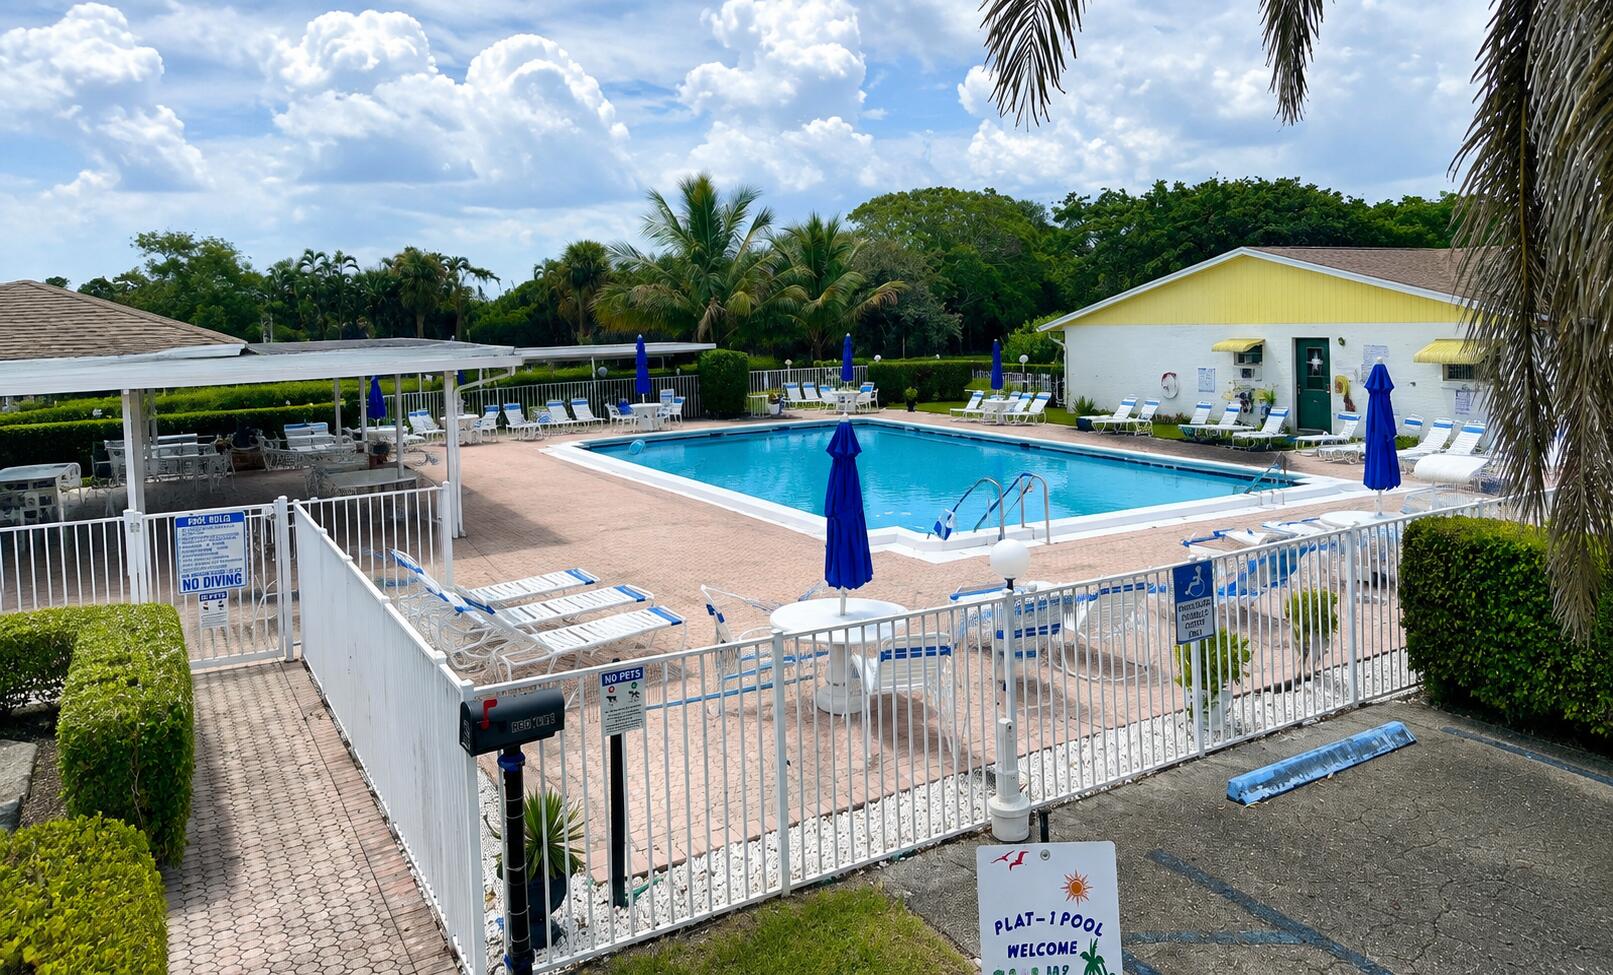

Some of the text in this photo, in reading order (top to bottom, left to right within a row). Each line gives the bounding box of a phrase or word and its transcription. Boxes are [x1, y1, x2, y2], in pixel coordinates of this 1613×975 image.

[182, 578, 199, 591] NO
[203, 573, 242, 588] DIVING
[604, 669, 640, 684] NO PETS
[1060, 911, 1103, 937] POOL
[1007, 940, 1078, 959] WELCOME
